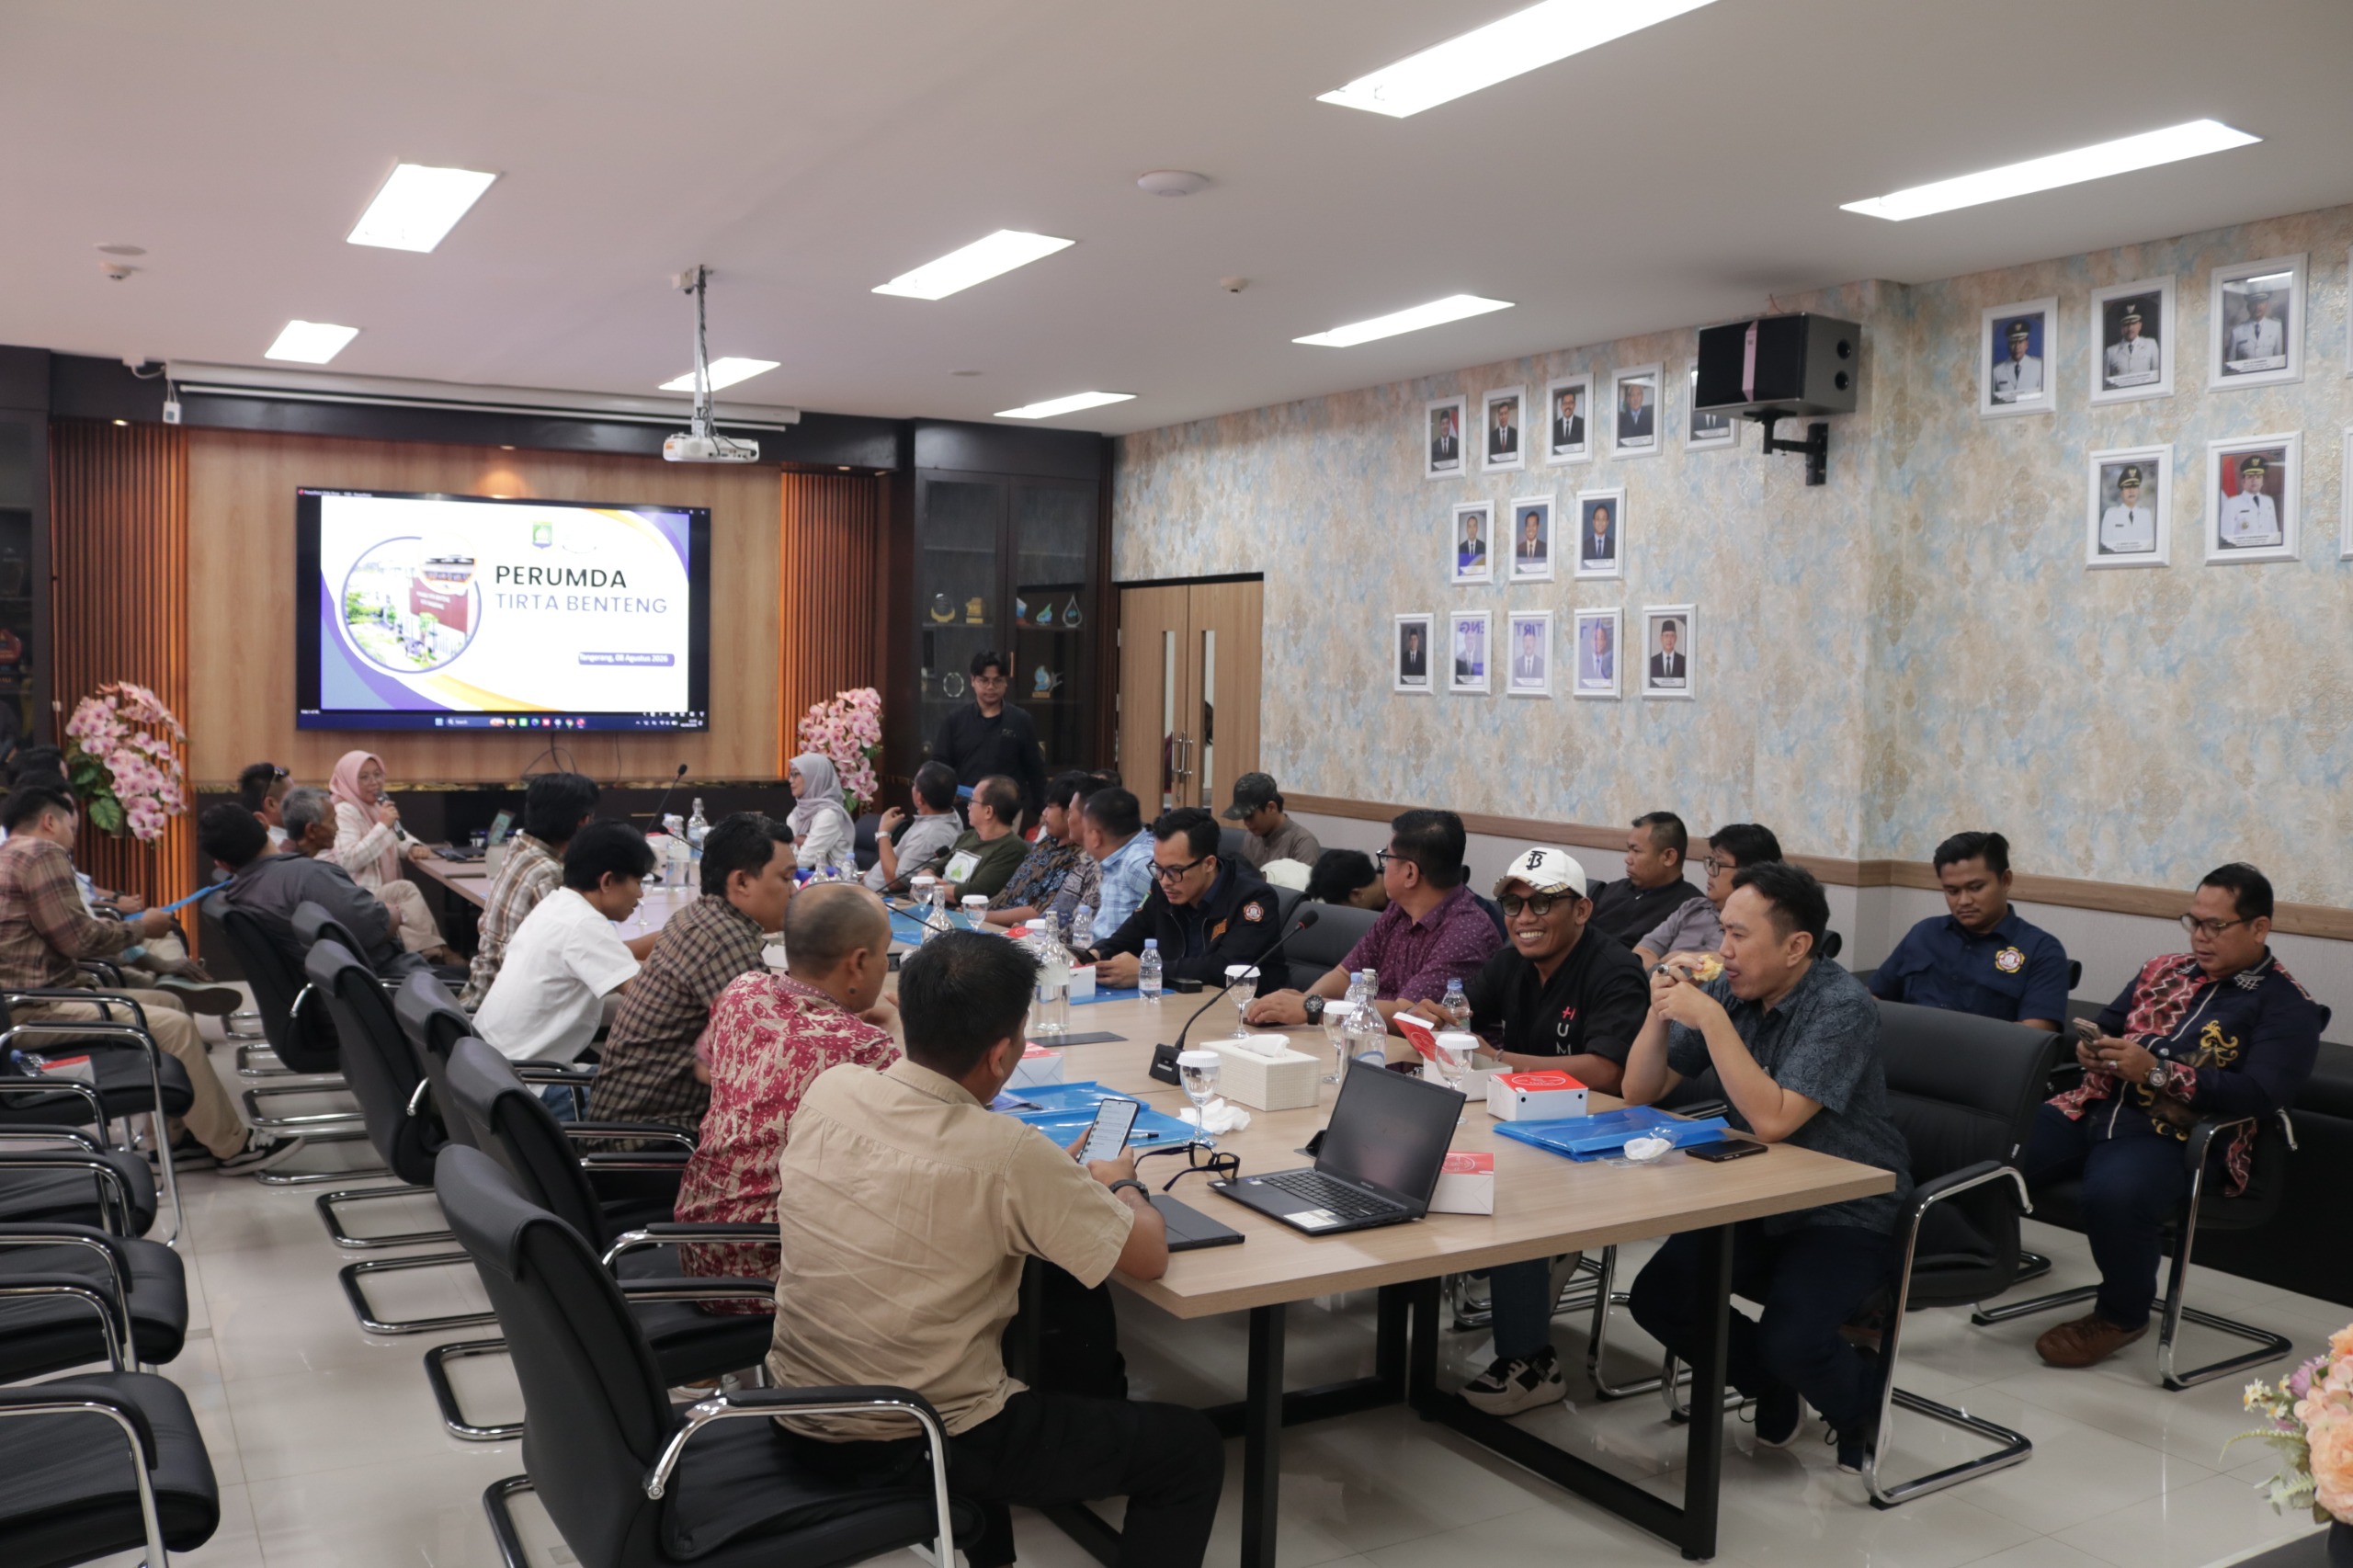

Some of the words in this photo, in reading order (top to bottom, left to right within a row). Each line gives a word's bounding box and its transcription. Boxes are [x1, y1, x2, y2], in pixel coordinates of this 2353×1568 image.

[495, 565, 627, 588] PERUMDA
[495, 593, 559, 610] TIRTA
[566, 596, 667, 614] BENTENG
[625, 653, 651, 664] Agustus
